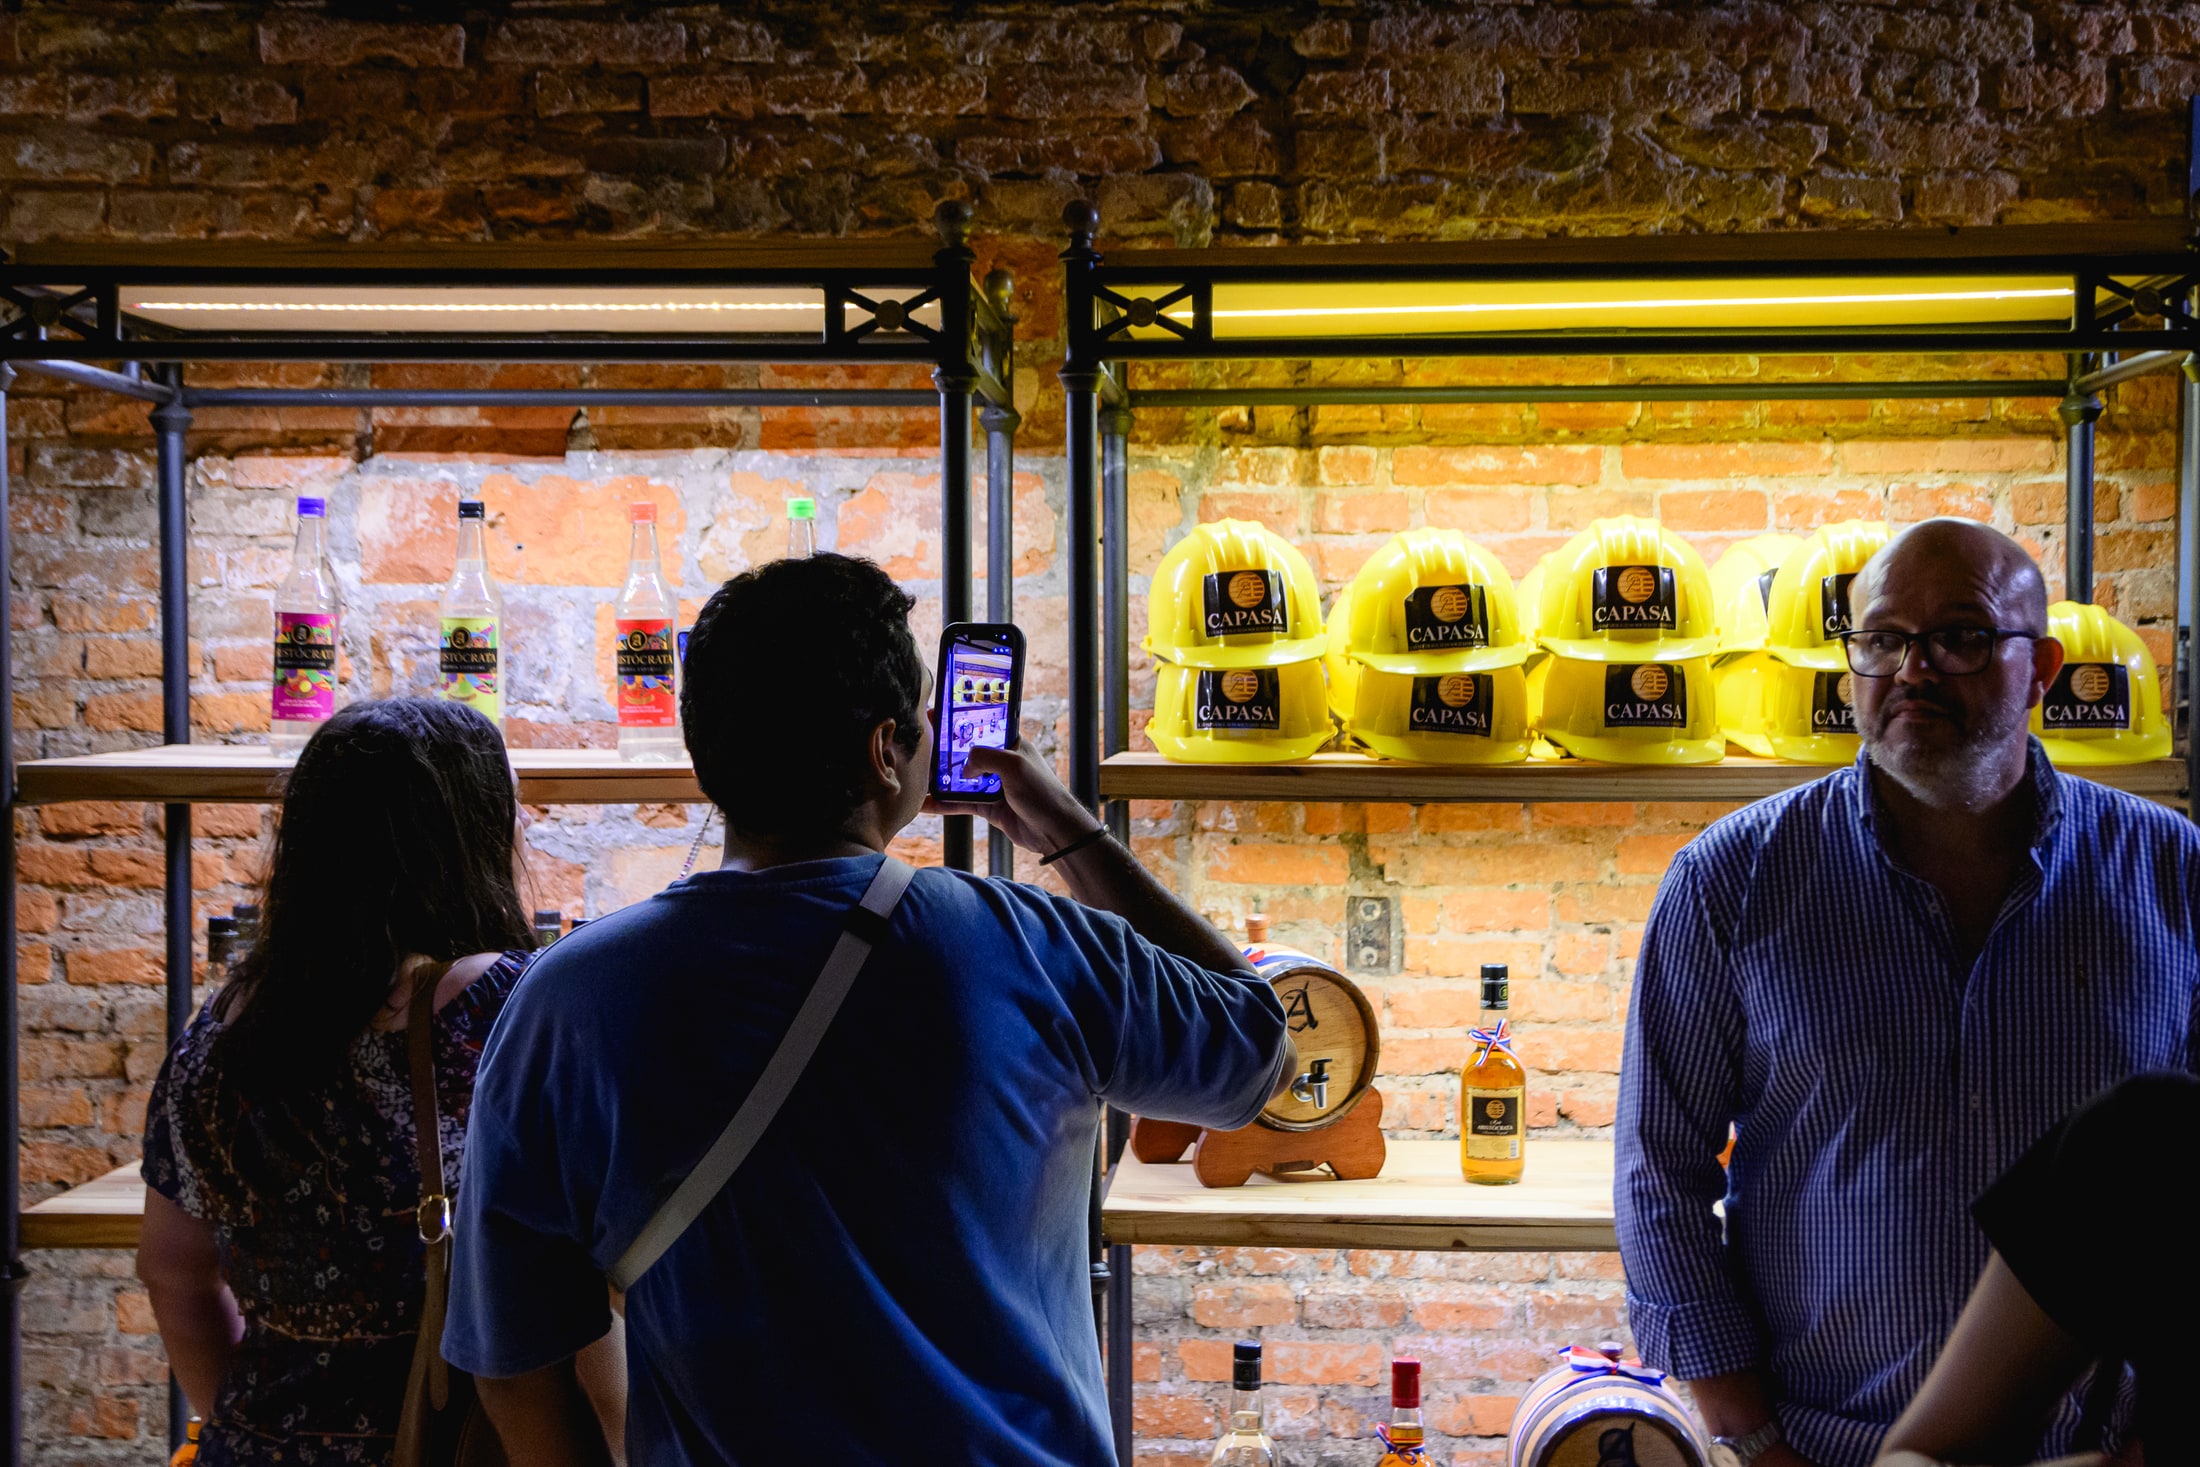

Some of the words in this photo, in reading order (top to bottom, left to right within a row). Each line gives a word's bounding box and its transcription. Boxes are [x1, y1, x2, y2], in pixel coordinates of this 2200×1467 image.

[1207, 608, 1283, 629] CAPASA
[1594, 605, 1672, 623] CAPASA
[1409, 623, 1485, 643] CAPASA
[1198, 705, 1275, 721] CAPASA
[1412, 707, 1487, 728] CAPASA
[1607, 703, 1683, 720] CAPASA
[1813, 708, 1856, 726] CAP
[2045, 704, 2126, 721] CAPASA
